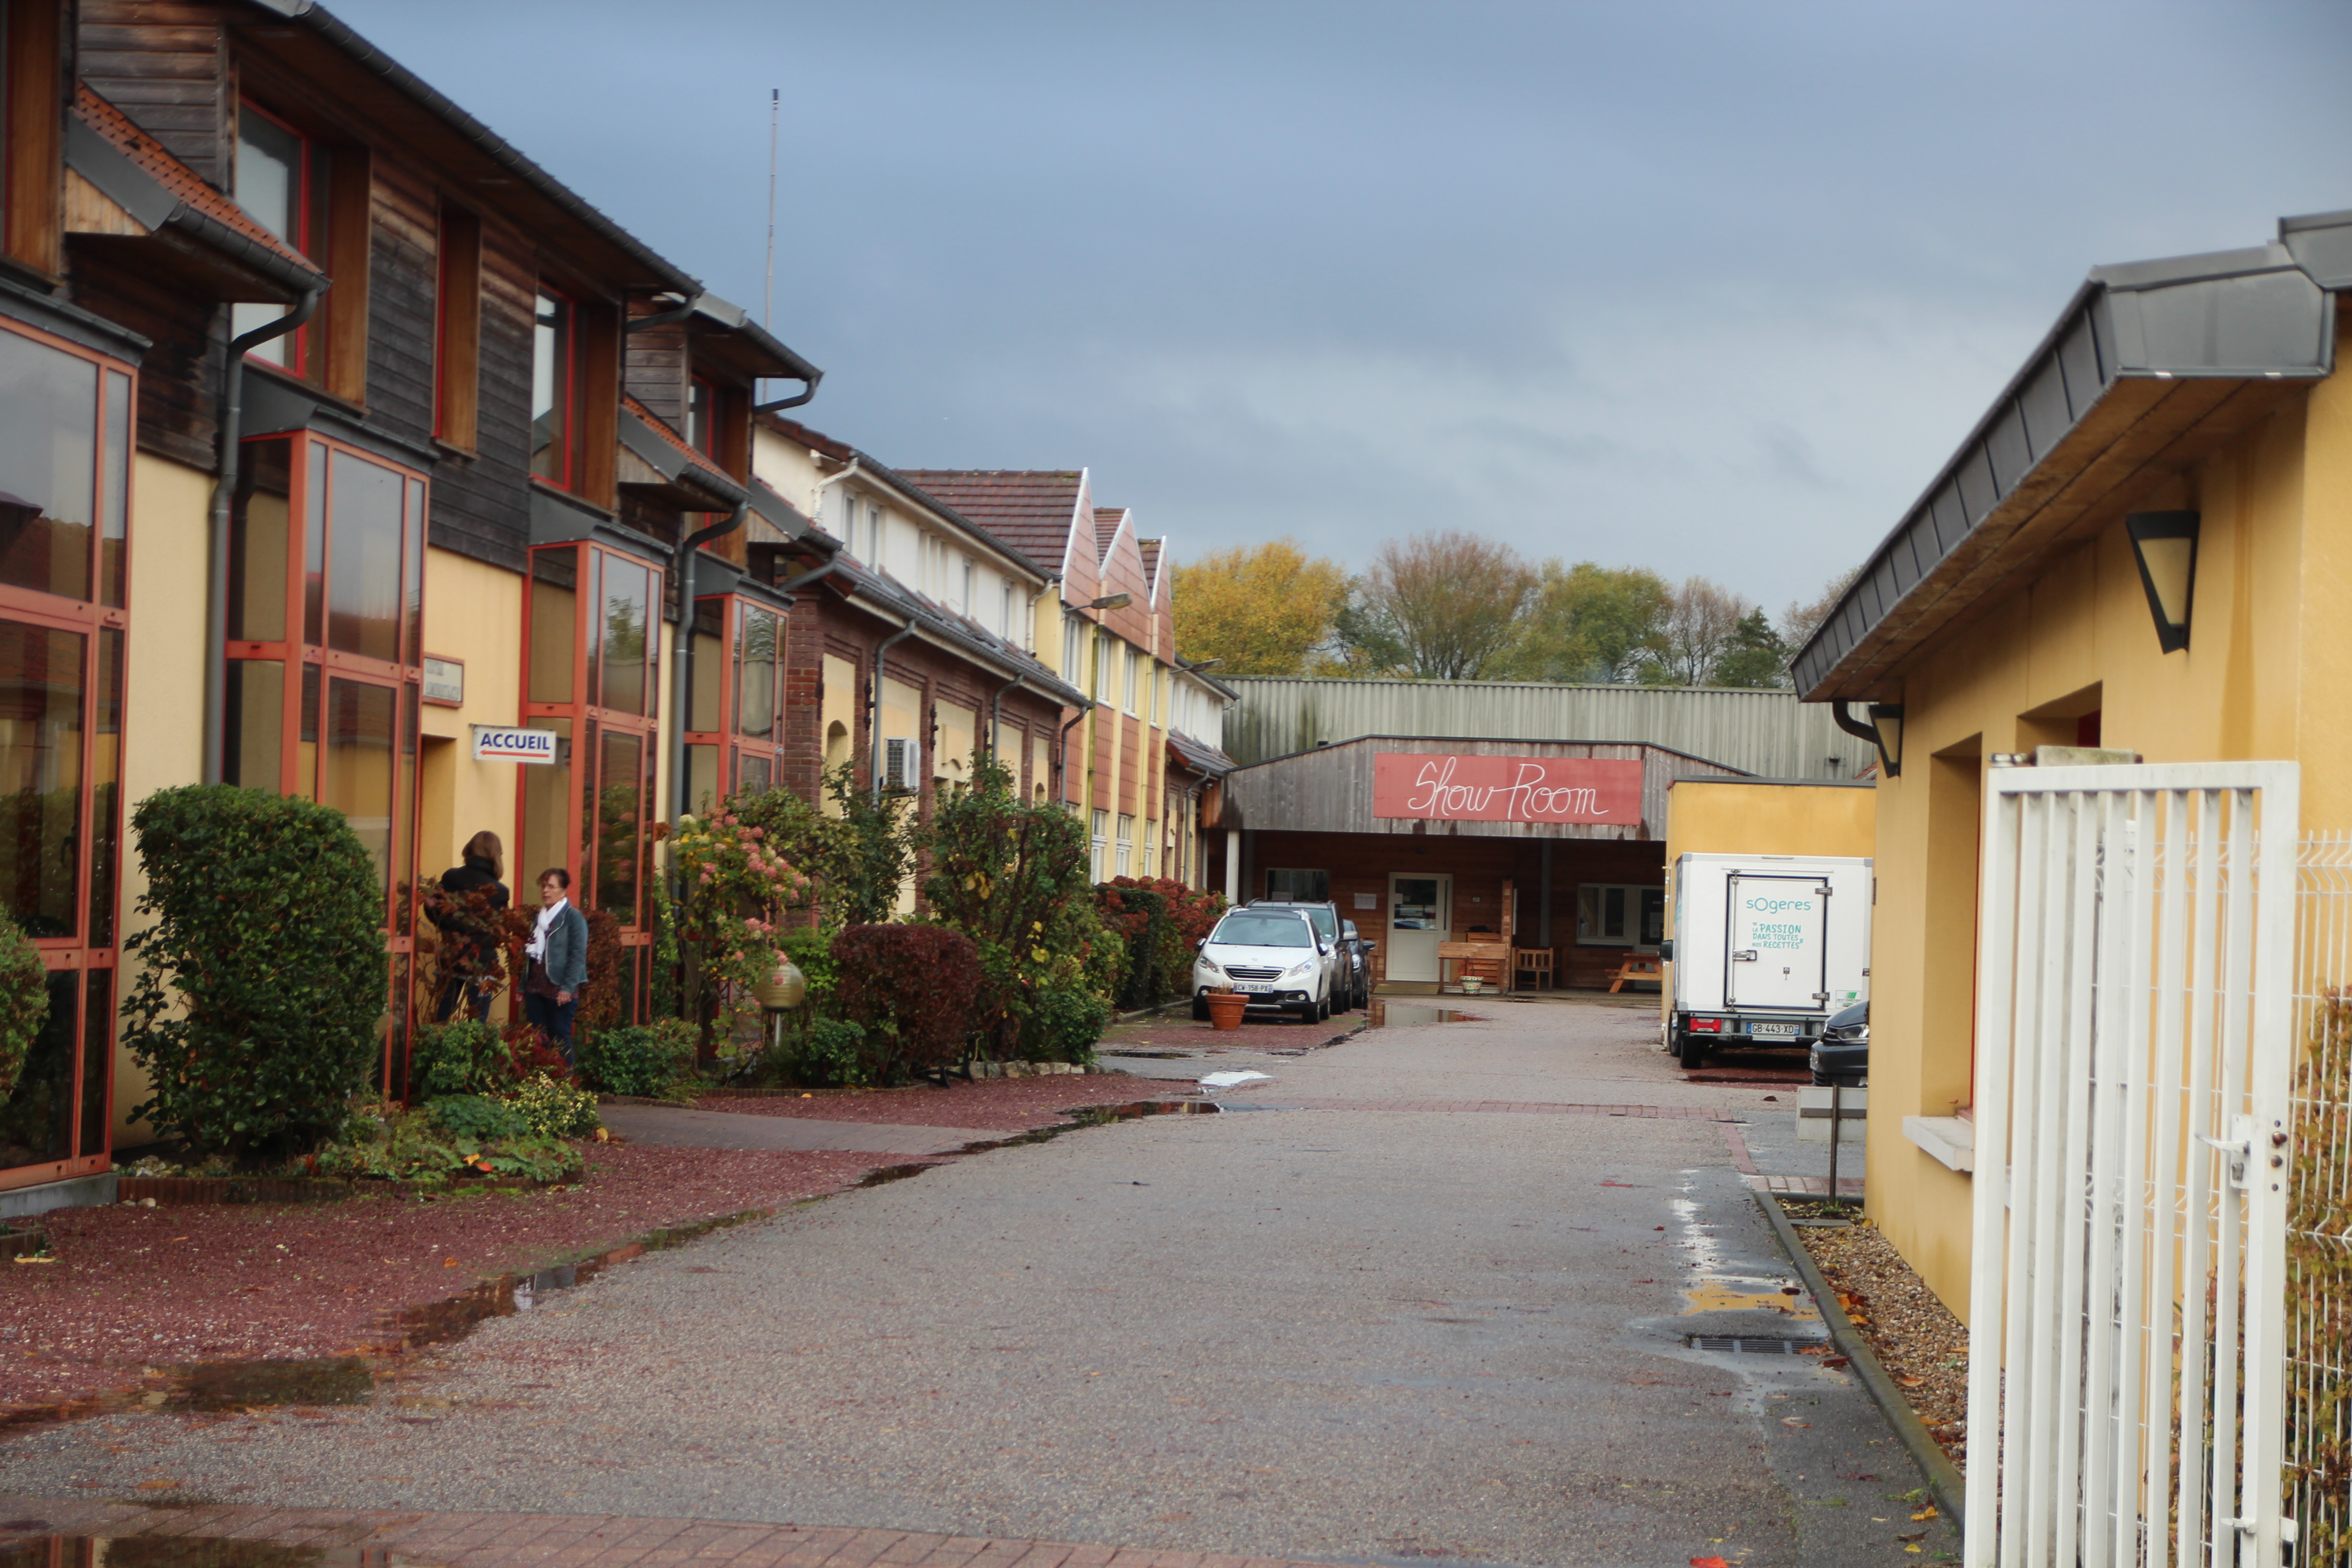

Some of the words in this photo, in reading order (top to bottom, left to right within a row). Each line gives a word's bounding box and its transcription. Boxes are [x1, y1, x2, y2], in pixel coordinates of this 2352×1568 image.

[480, 733, 550, 750] ACCUEIL
[1408, 756, 1494, 817] Show
[1507, 763, 1609, 819] Room
[1760, 923, 1801, 934] PASSION
[1752, 1024, 1794, 1034] GB-443-XD
